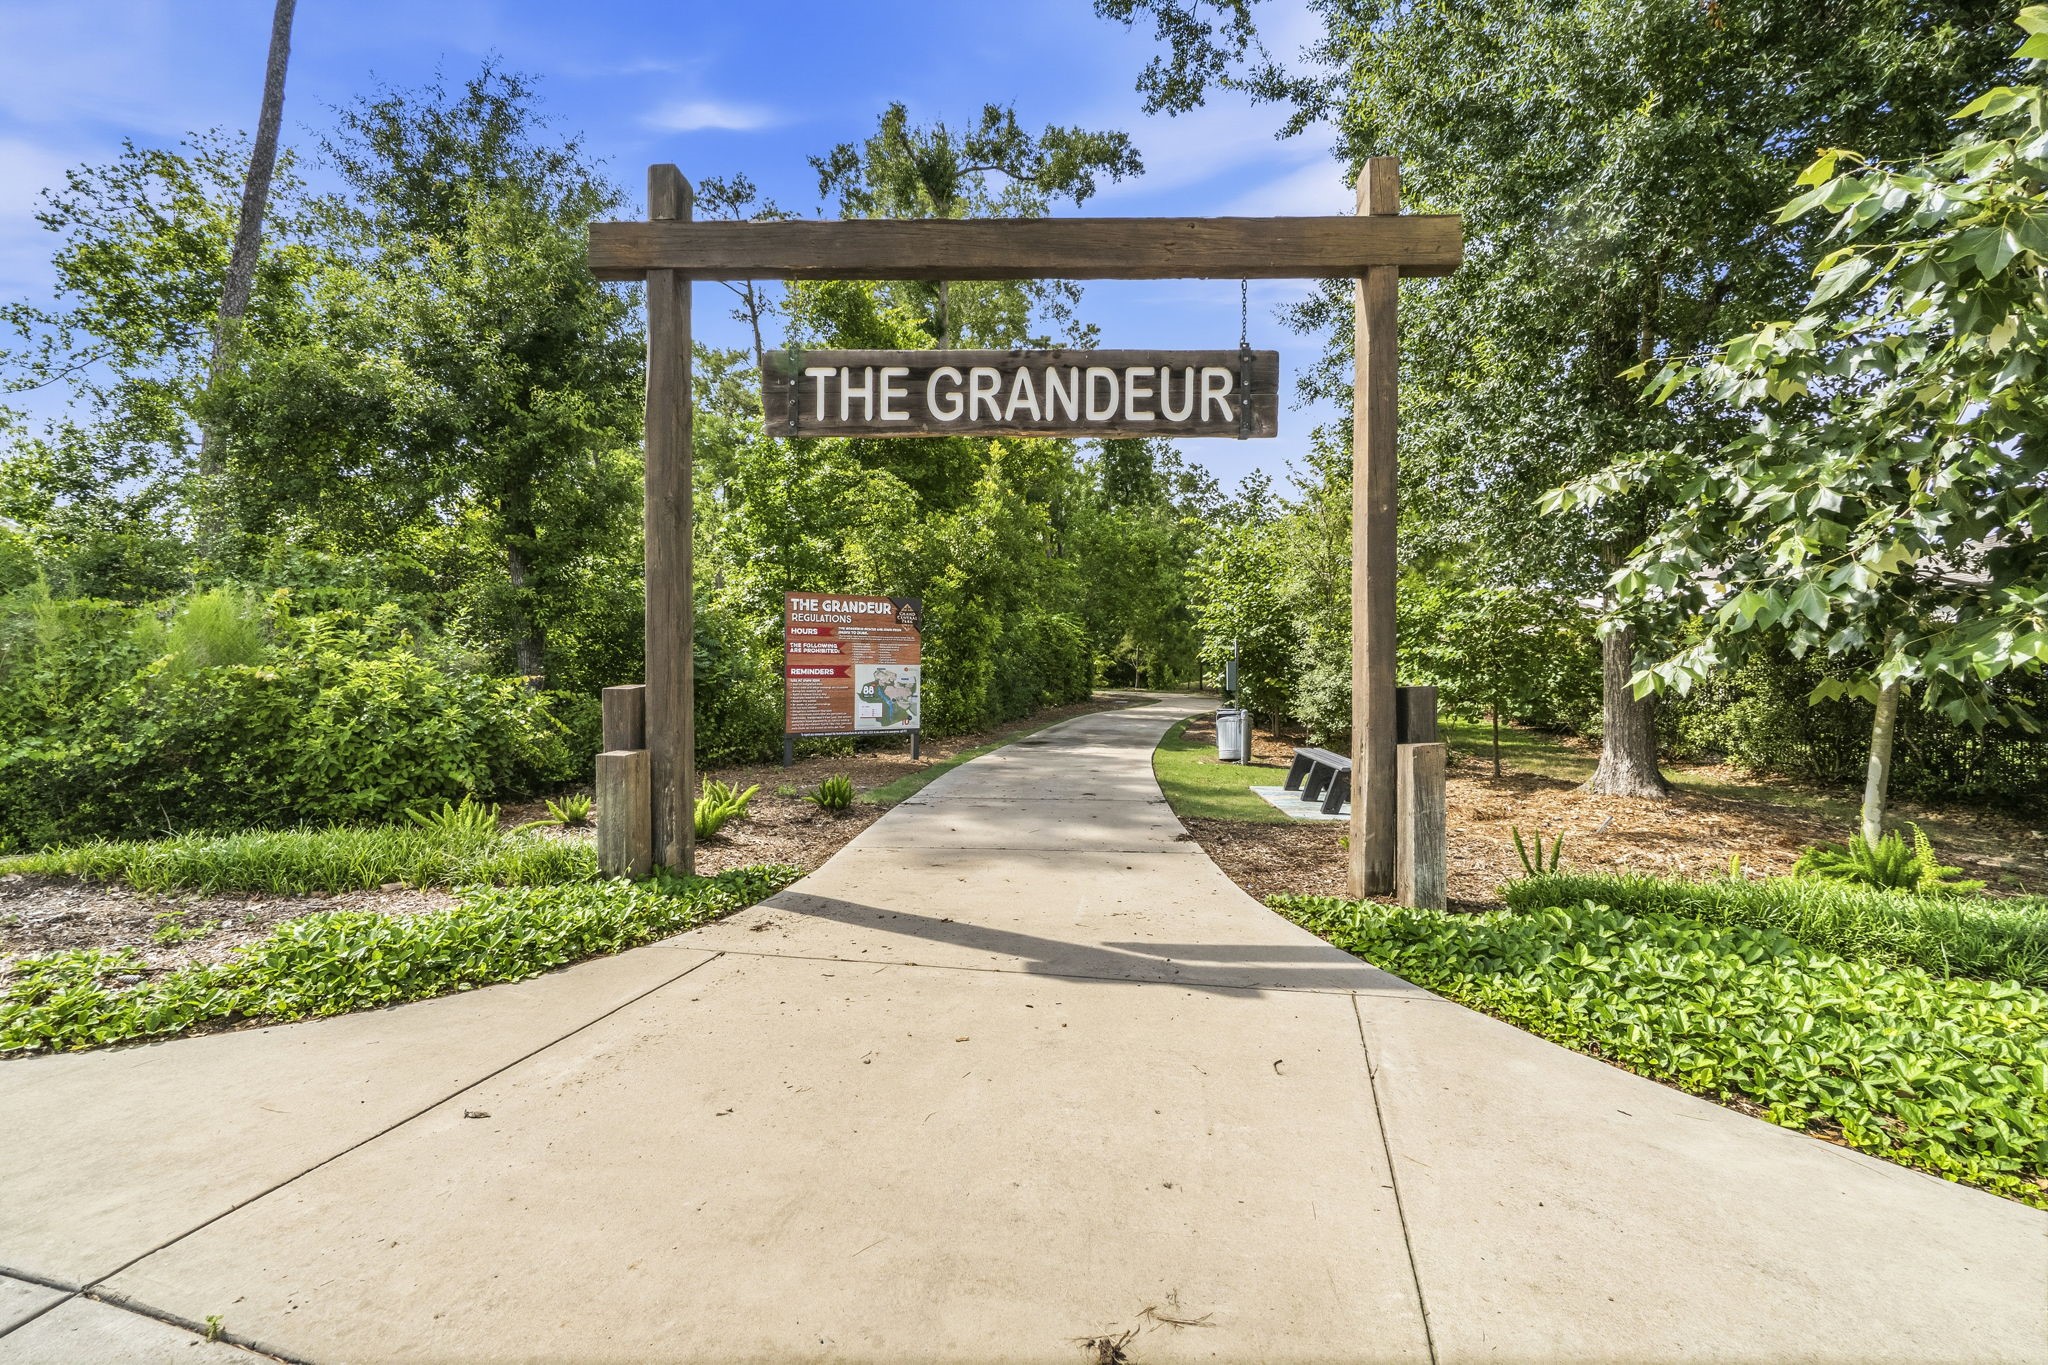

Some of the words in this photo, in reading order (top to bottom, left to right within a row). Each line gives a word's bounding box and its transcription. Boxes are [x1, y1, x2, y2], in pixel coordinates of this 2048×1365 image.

[804, 366, 909, 421] THE
[926, 366, 1234, 422] GRANDEUR
[791, 598, 819, 611] THE
[822, 599, 892, 615] GRANDEUR
[791, 612, 852, 624] REGULATIONS
[790, 627, 818, 635] HOURS
[863, 685, 875, 695] 88
